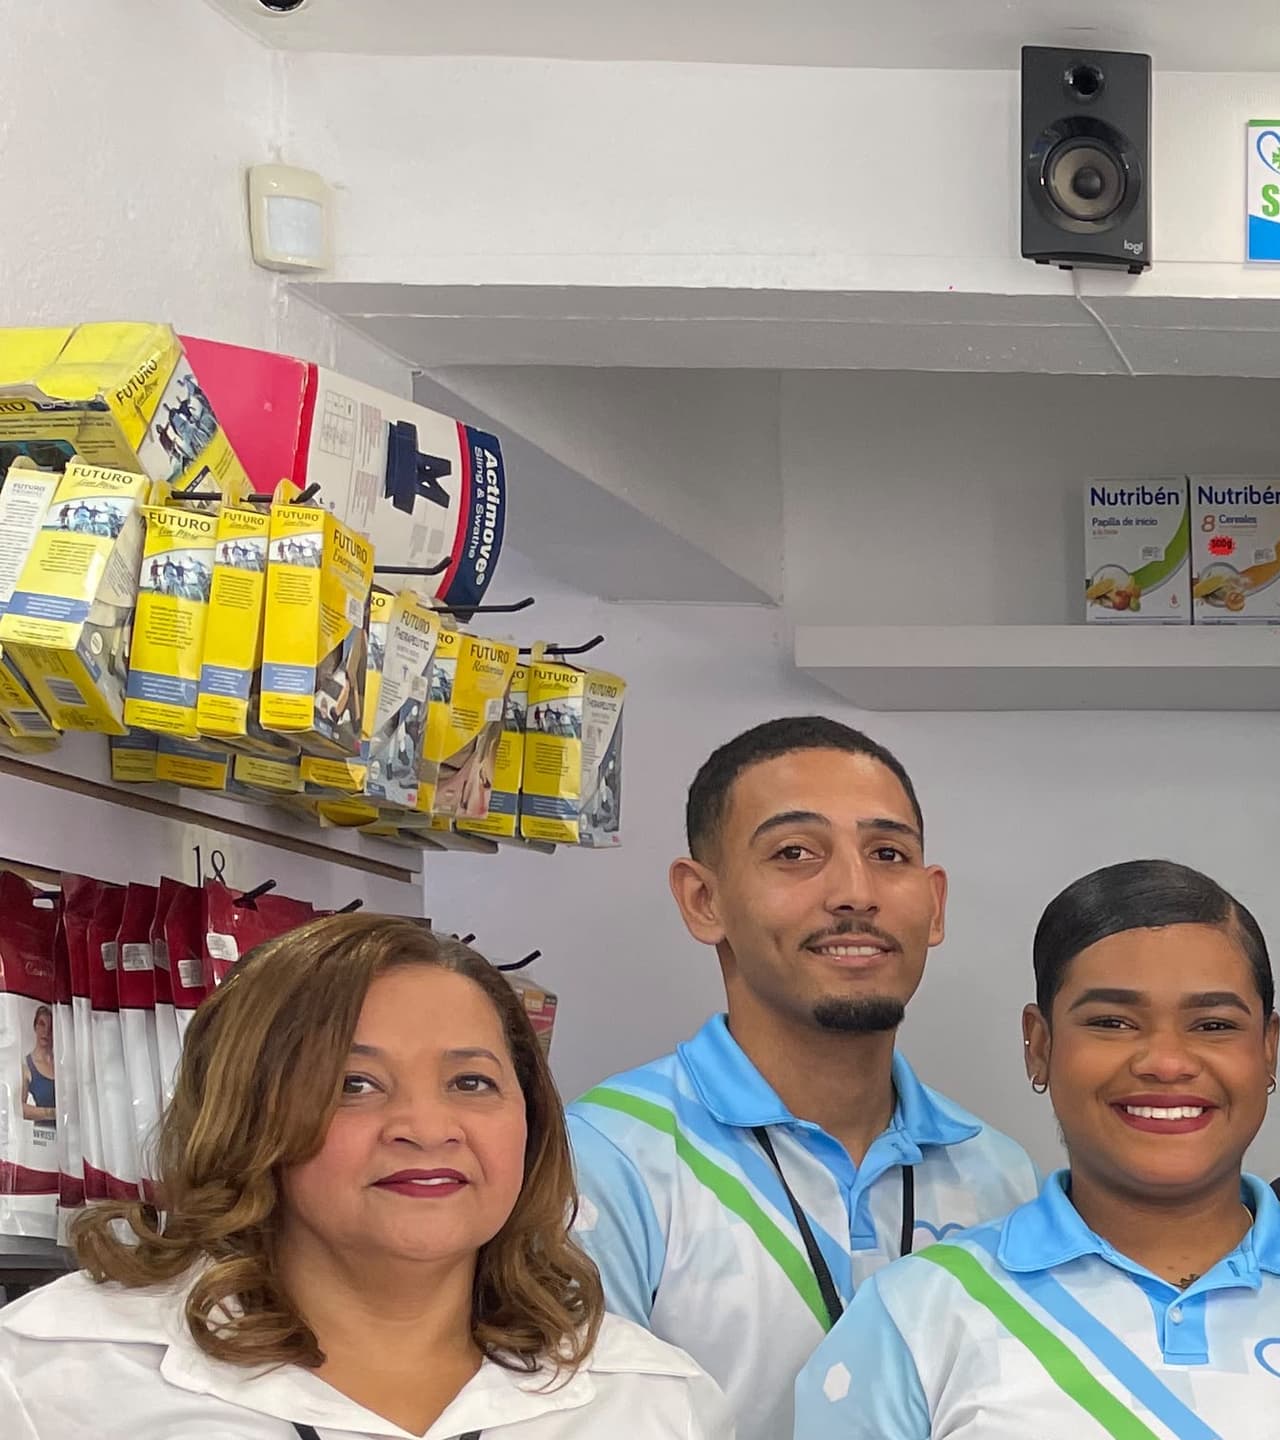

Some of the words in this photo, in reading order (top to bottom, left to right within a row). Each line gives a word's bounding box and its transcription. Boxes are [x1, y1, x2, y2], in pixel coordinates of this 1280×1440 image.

[1124, 240, 1143, 254] logi
[116, 358, 158, 404] FUTURO
[72, 466, 133, 485] FUTURO
[1090, 487, 1180, 507] Nutribén
[149, 511, 211, 532] FUTURO
[223, 511, 265, 526] FUTURO
[277, 509, 319, 522] FUTURO
[1122, 516, 1134, 526] de
[1135, 516, 1158, 526] inicio
[1201, 515, 1216, 532] 8
[333, 529, 368, 565] FUTURO
[400, 610, 431, 635] FUTURO
[470, 643, 510, 665] FUTURO
[533, 669, 579, 684] FUTURO
